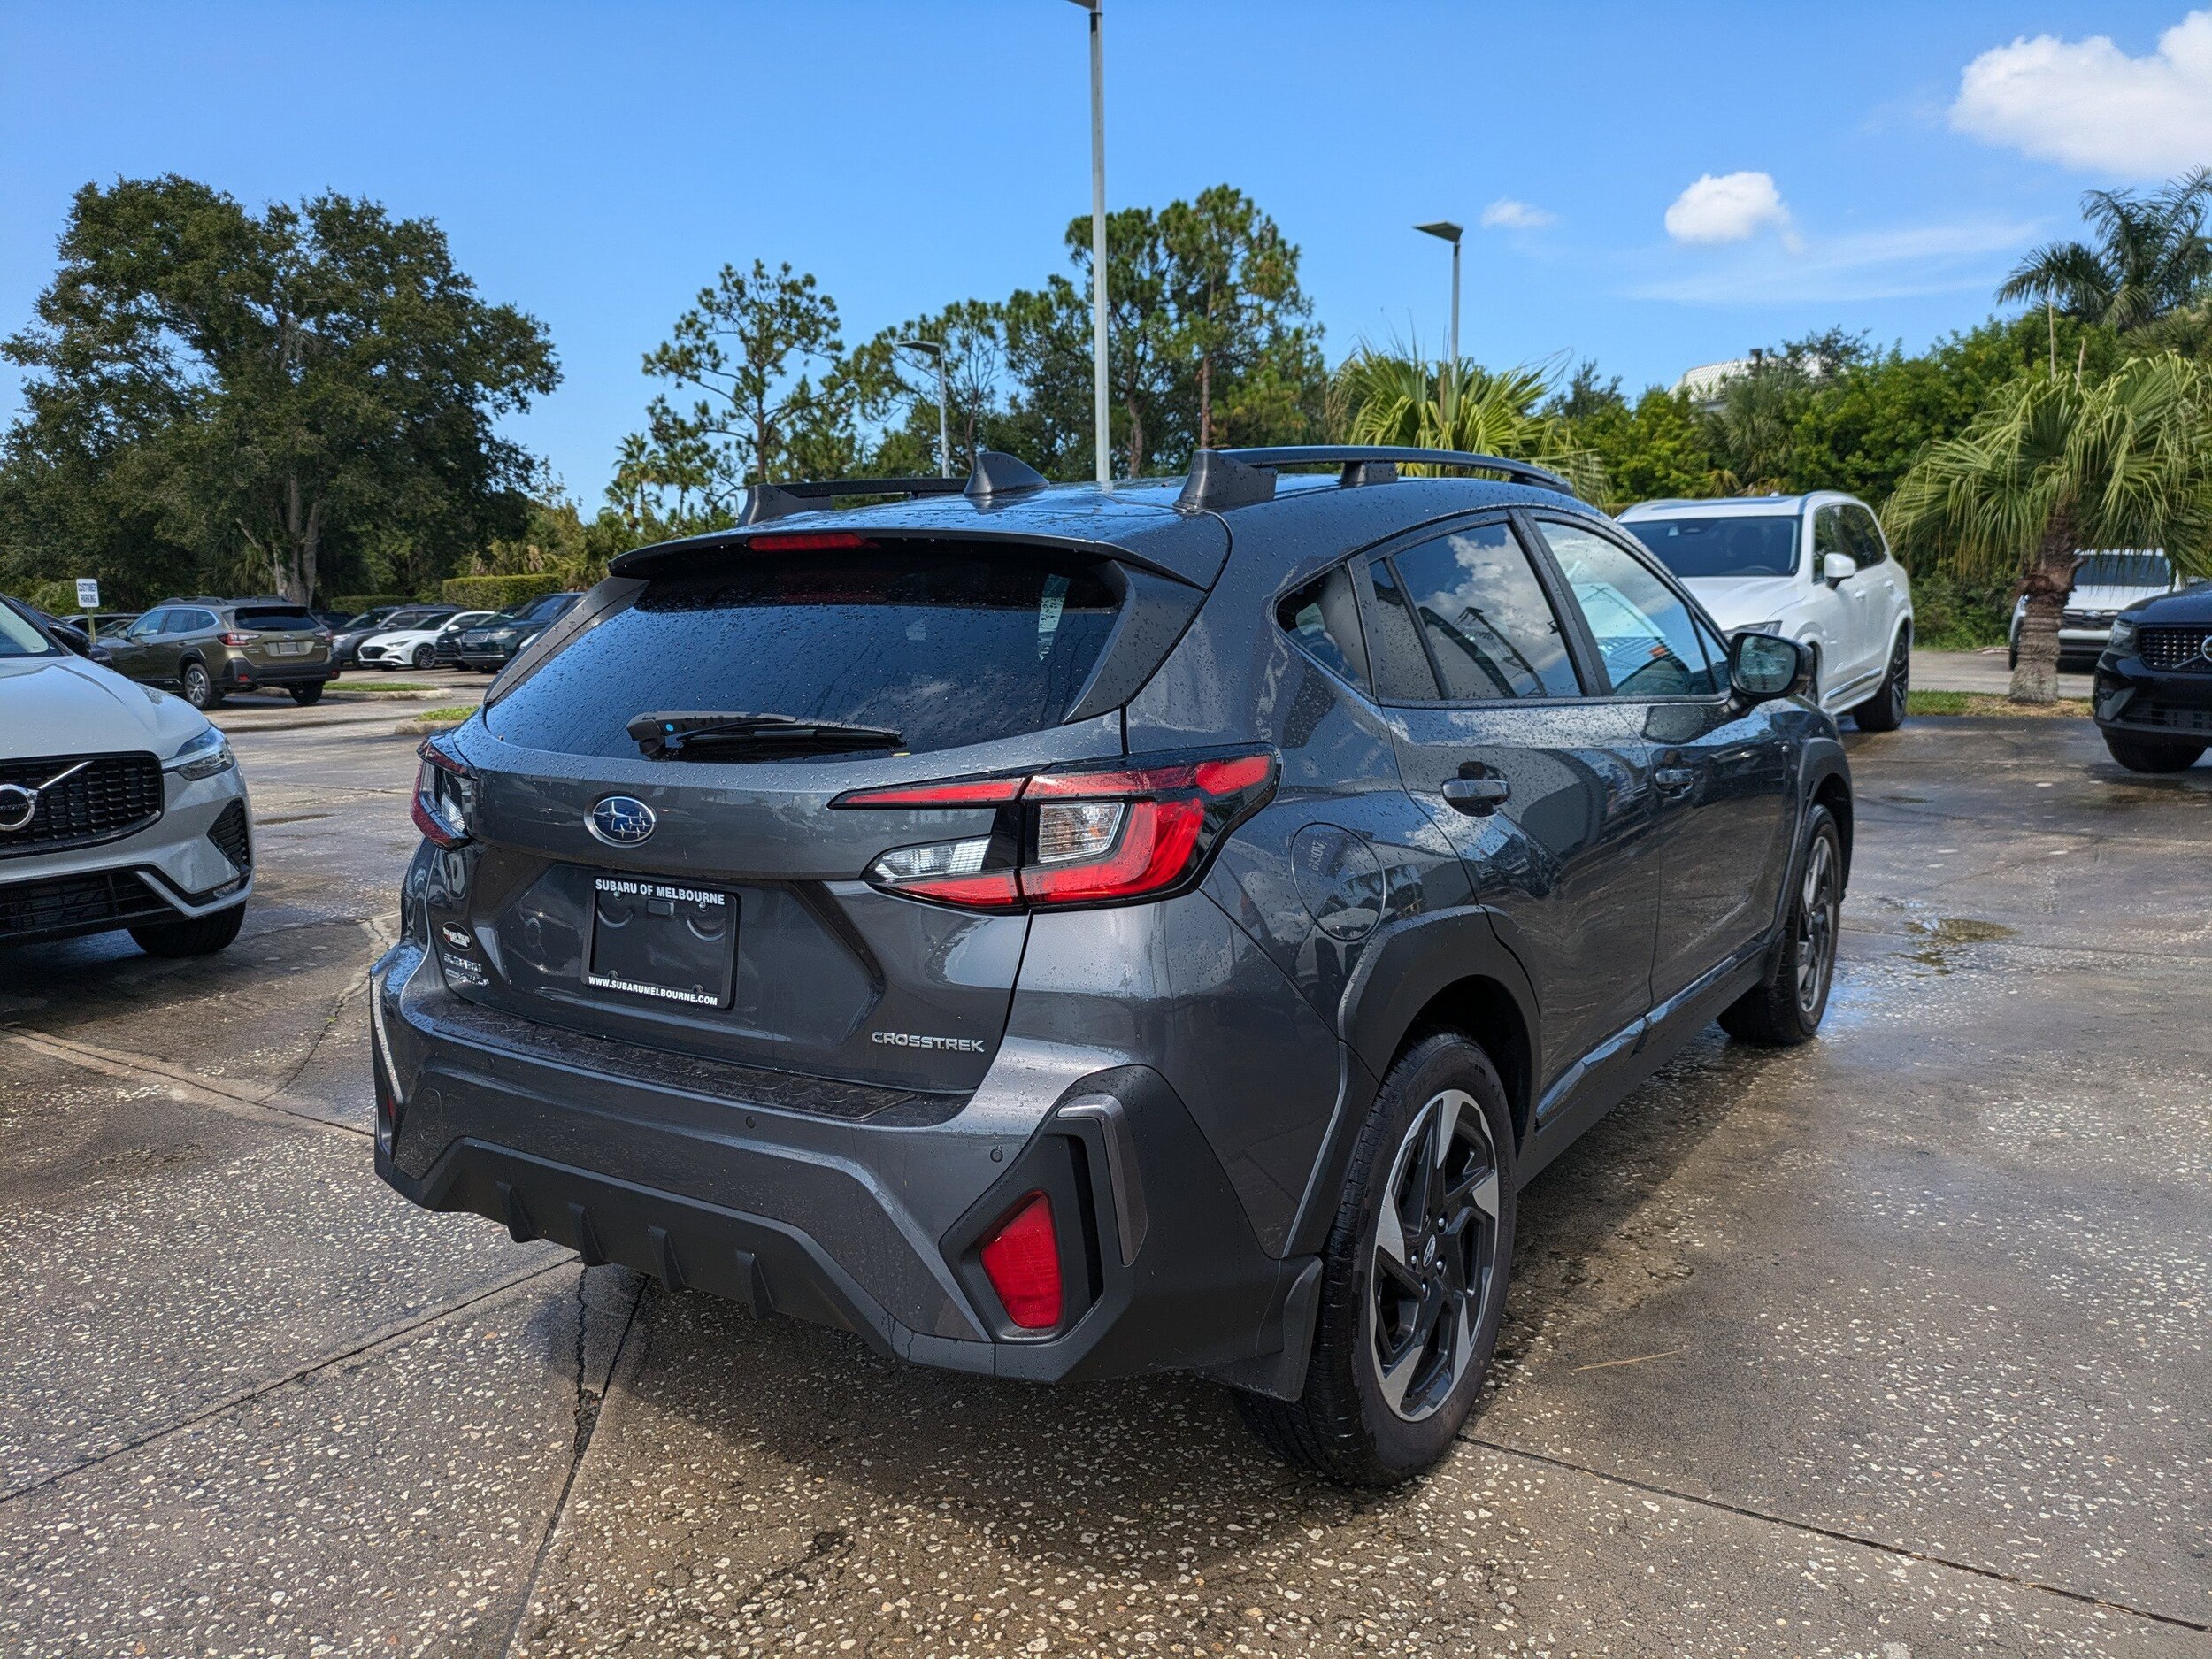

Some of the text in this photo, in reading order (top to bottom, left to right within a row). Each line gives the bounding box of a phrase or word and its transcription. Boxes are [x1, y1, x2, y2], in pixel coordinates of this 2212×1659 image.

[595, 879, 725, 905] SUBARU OF MELBOURNE
[588, 976, 718, 1005] WWW.SUBARUMELBOURNE.COM
[871, 1031, 985, 1053] CROSSTREK
